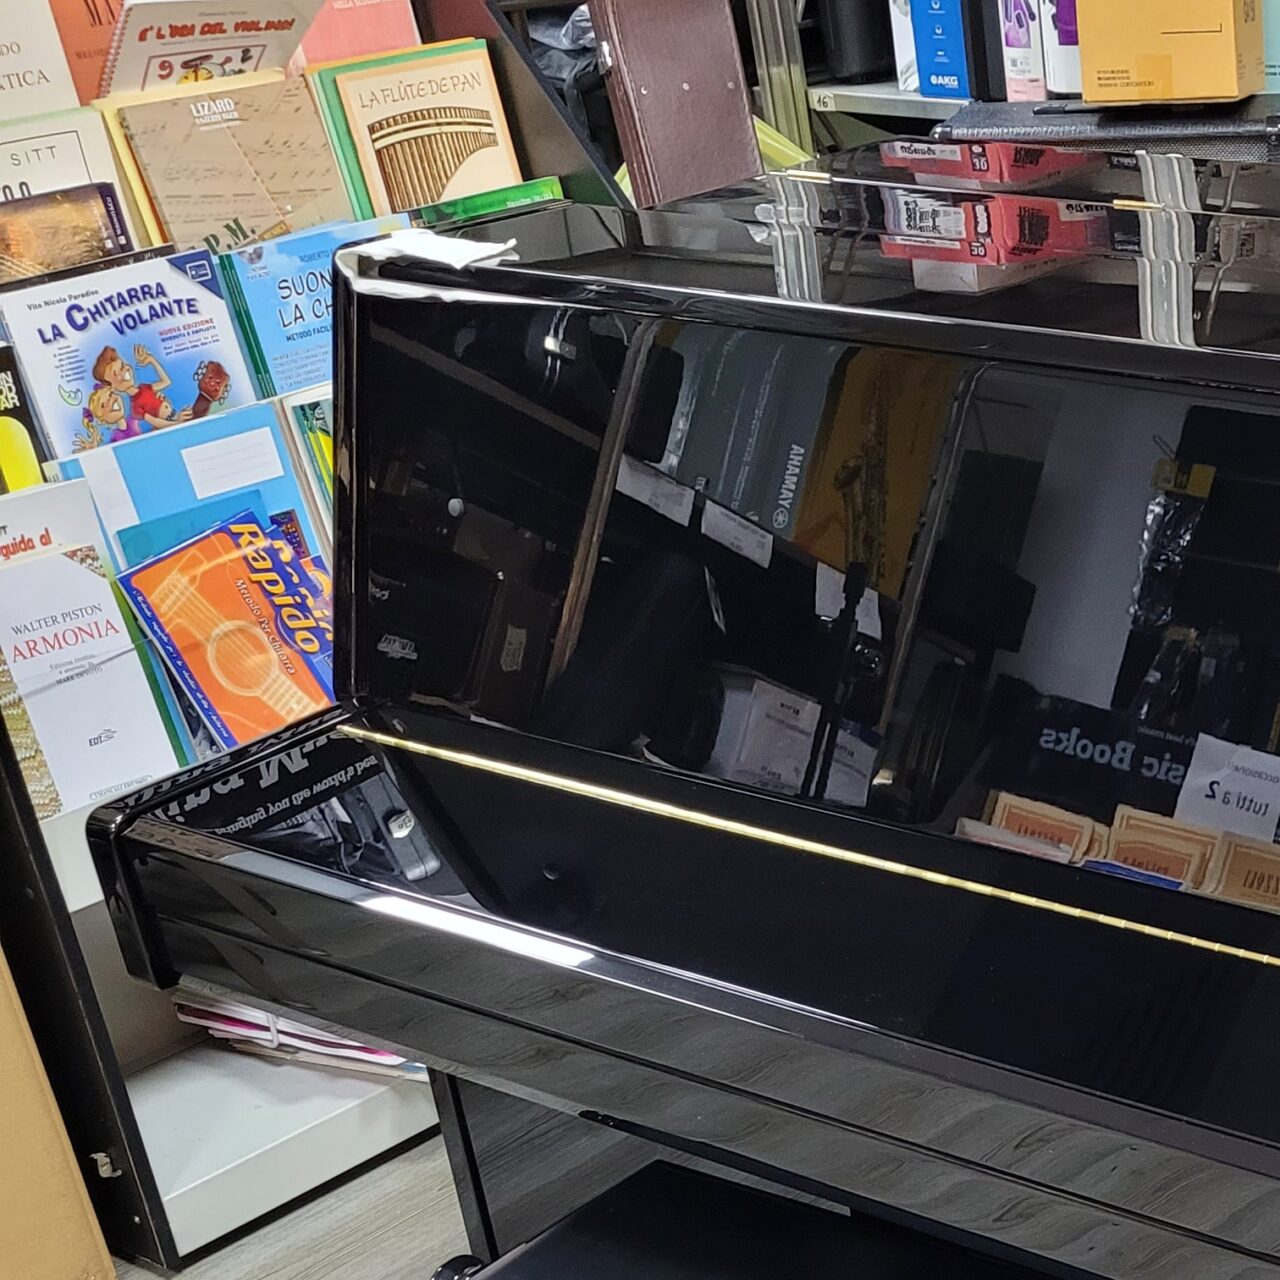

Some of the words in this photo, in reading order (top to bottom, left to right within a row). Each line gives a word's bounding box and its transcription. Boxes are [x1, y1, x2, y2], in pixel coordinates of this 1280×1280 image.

[938, 75, 959, 86] AKG
[190, 97, 235, 117] LIZARD
[27, 299, 44, 311] Vito
[44, 293, 66, 308] Nicola
[68, 288, 99, 304] Paradiso
[112, 298, 199, 336] VOLANTE
[278, 303, 306, 329] LA
[37, 325, 64, 345] LA
[313, 324, 333, 336] FACIL
[39, 527, 52, 546] al
[229, 523, 321, 653] Rapido
[11, 615, 60, 636] WALTER
[61, 603, 103, 624] PISTON
[235, 578, 261, 617] Metodo
[268, 633, 296, 675] Chitarra
[12, 618, 120, 663] ARMONIA
[89, 735, 103, 747] EDT
